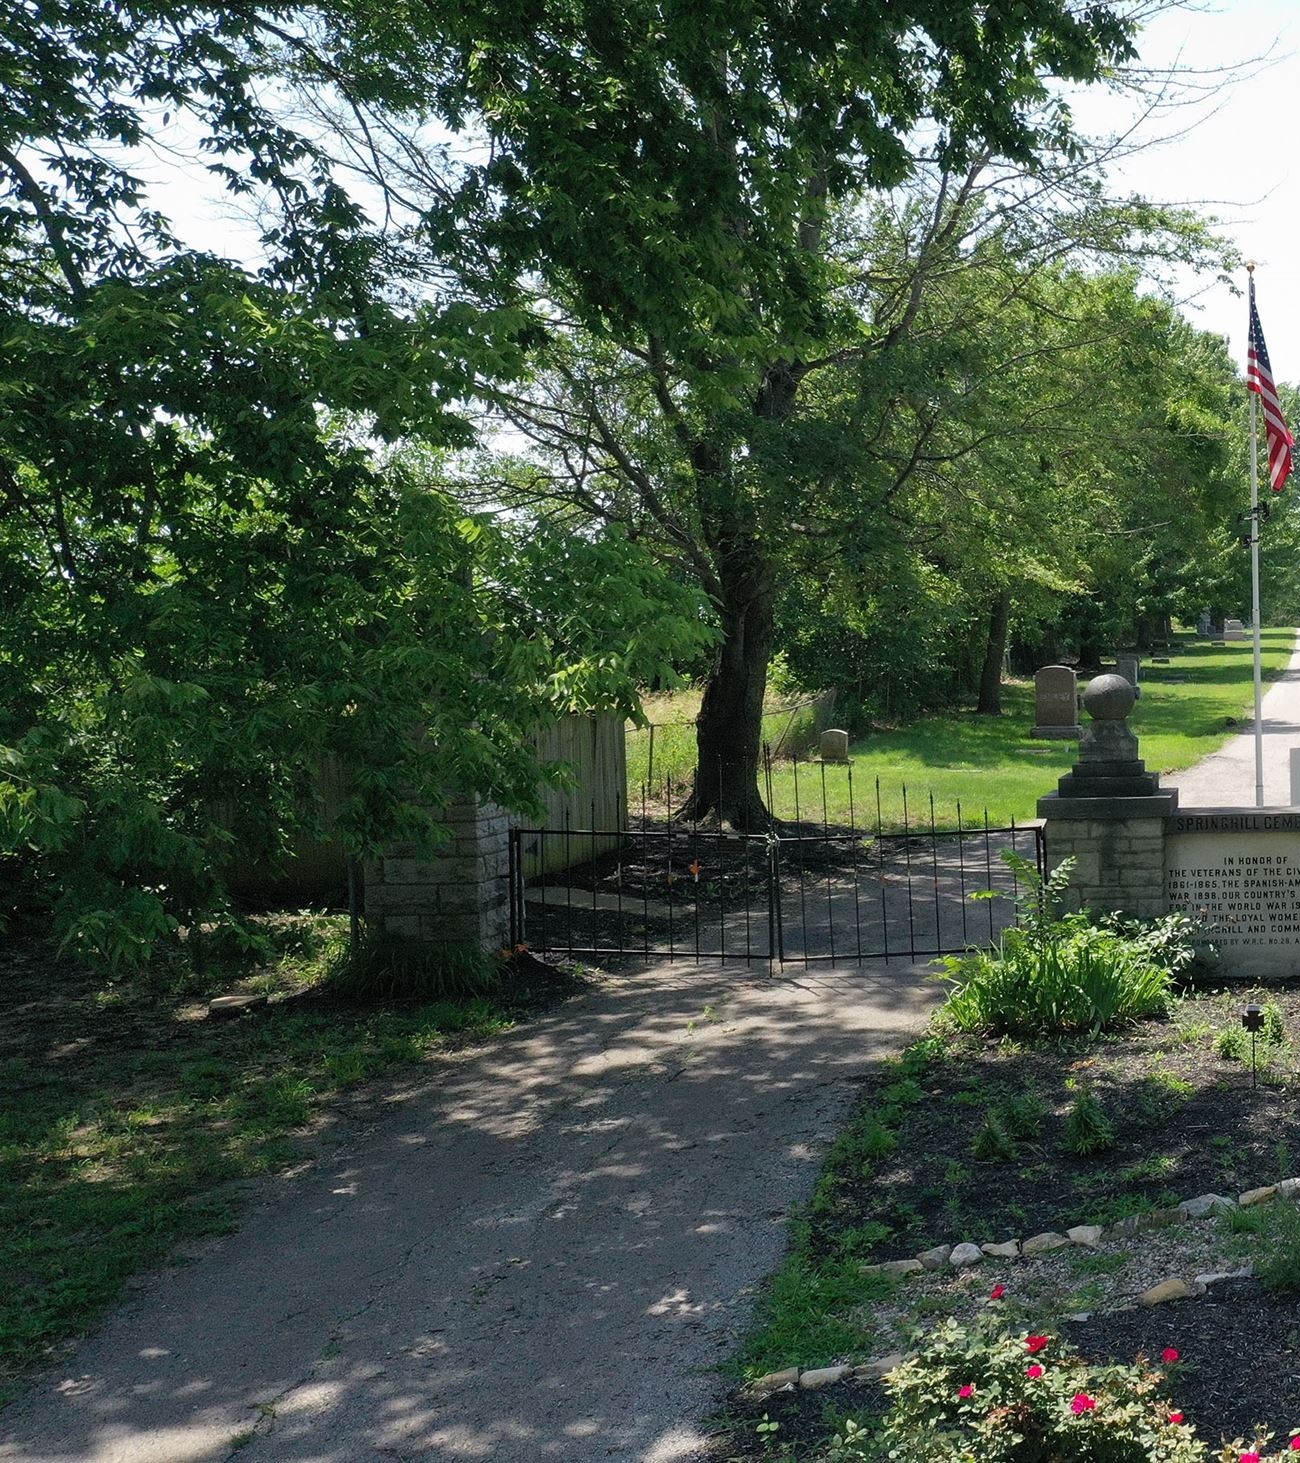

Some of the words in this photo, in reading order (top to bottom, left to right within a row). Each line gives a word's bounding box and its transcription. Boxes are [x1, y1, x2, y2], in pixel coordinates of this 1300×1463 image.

[1177, 816, 1258, 831] SPRINGHILL
[1223, 857, 1234, 865] IN
[1238, 856, 1272, 865] HONOR
[1276, 856, 1288, 864] OF
[1190, 869, 1242, 878] VETERANS
[1246, 868, 1258, 876] OF
[1263, 868, 1282, 876] THE
[1222, 880, 1240, 888] THE
[1169, 892, 1190, 900] WAR
[1222, 891, 1240, 900] OUR
[1244, 890, 1296, 899] COUNTRY'S
[1192, 903, 1201, 912] IN
[1205, 903, 1223, 911] THE
[1228, 902, 1261, 911] WORLD
[1266, 902, 1287, 910] WAR
[1213, 914, 1230, 922] THE
[1236, 914, 1264, 922] LOYAL
[1248, 925, 1266, 934] AND
